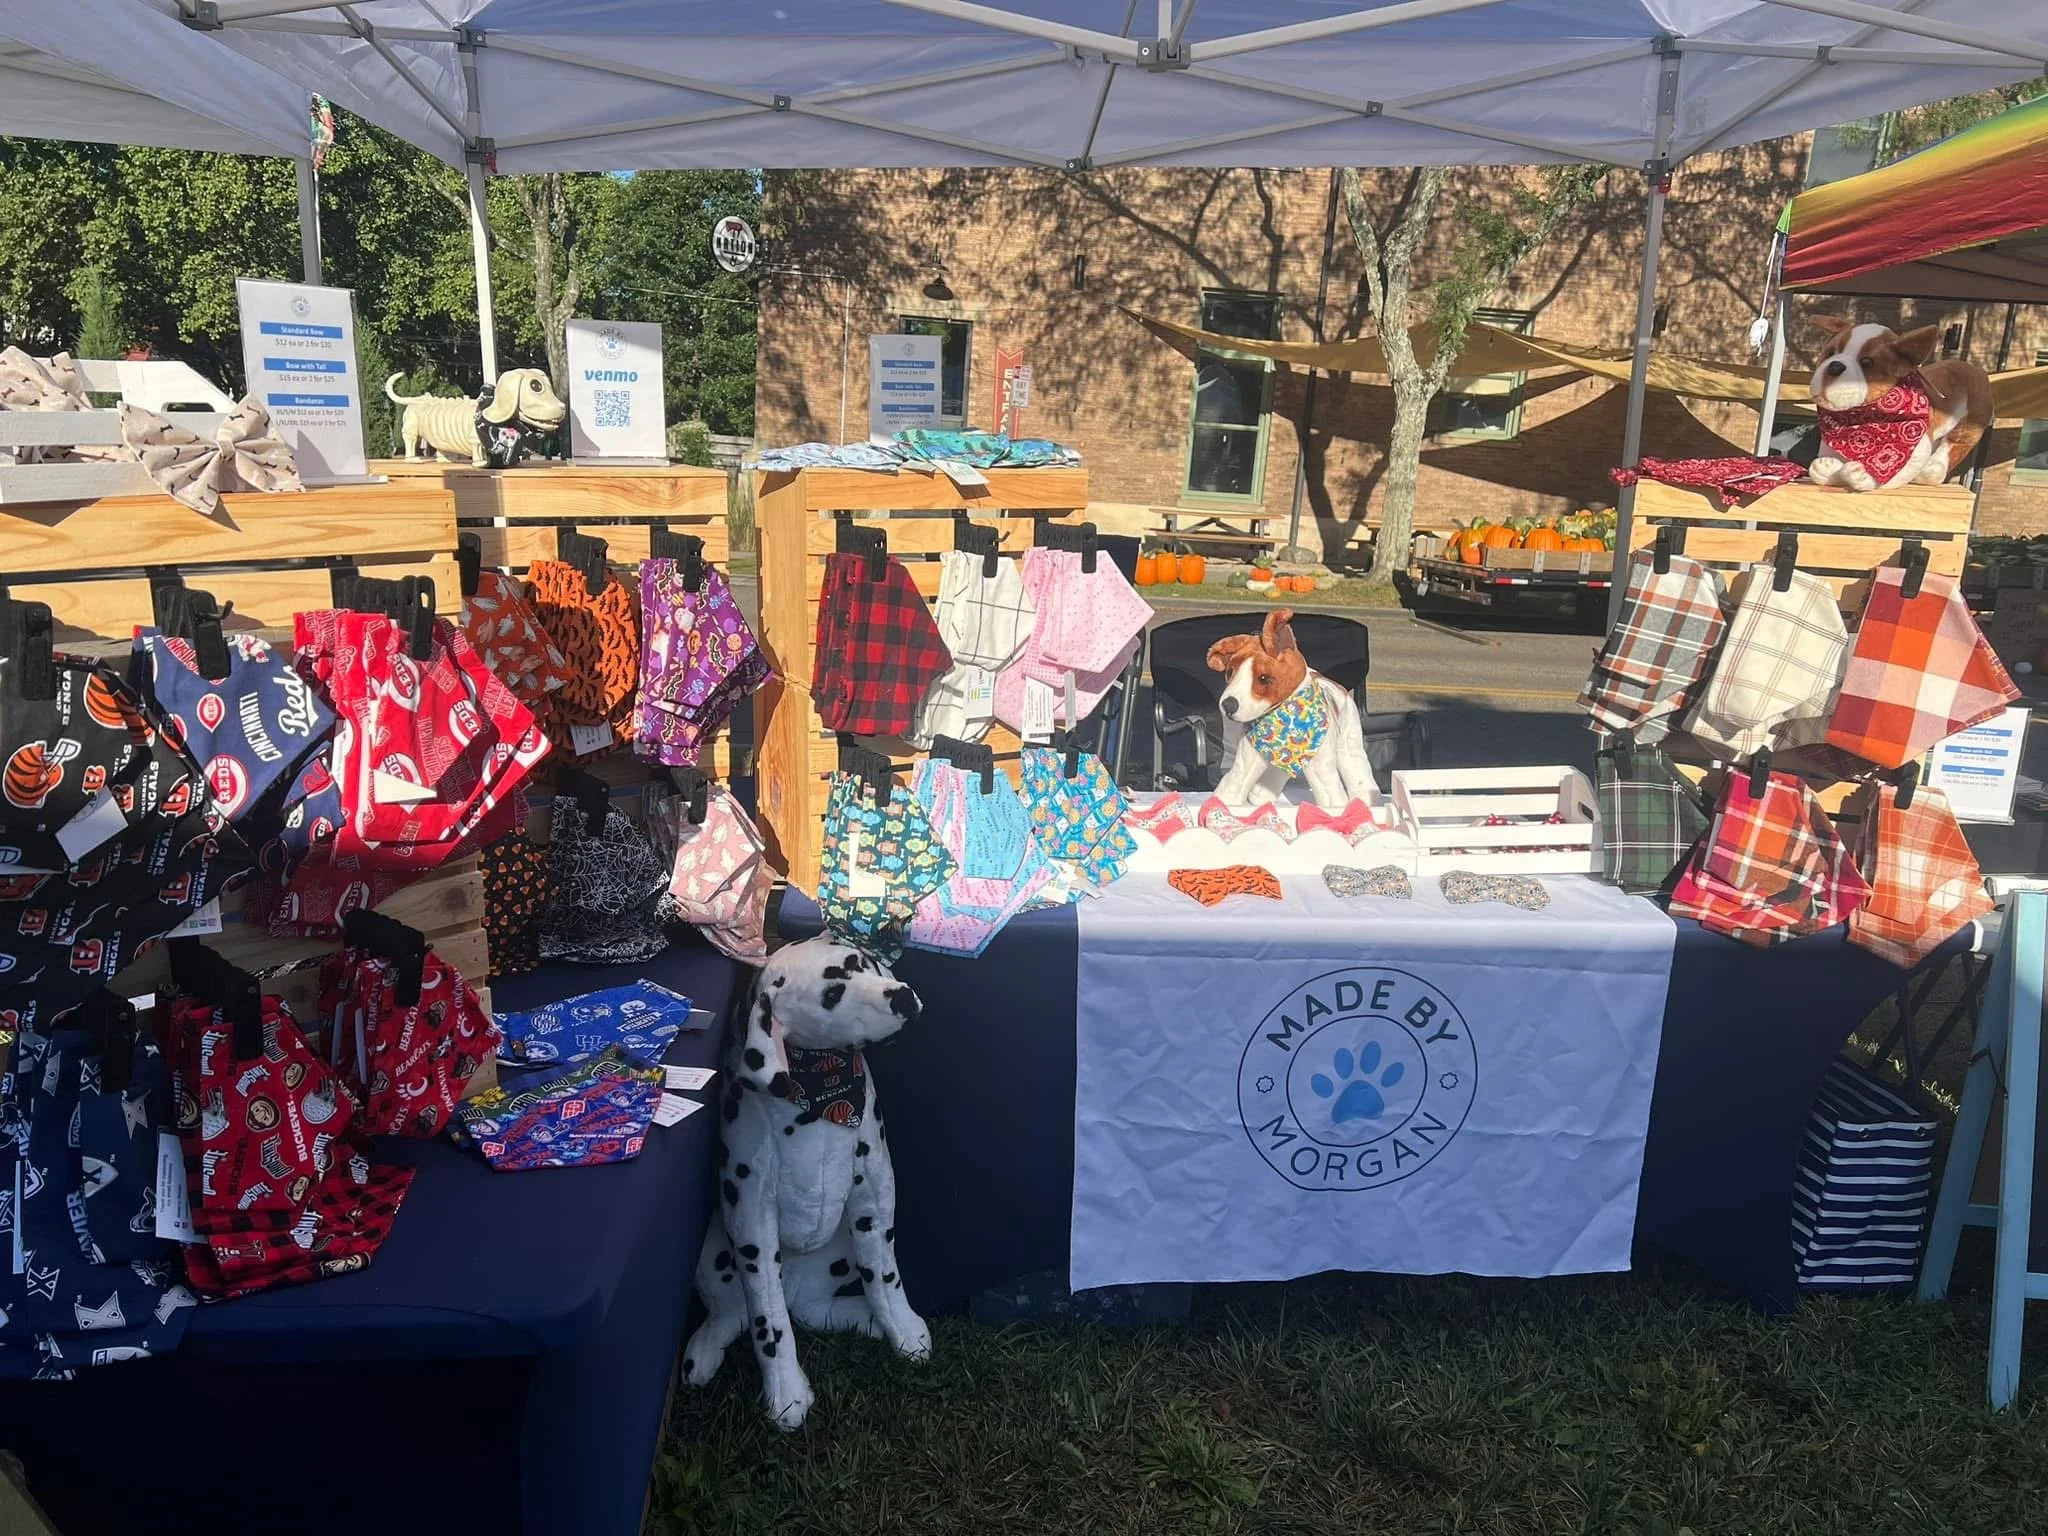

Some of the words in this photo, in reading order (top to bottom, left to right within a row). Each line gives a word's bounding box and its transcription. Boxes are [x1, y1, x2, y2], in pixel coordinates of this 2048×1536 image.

[717, 237, 753, 254] NATION
[276, 338, 287, 346] $12
[281, 326, 310, 335] Standard
[280, 374, 290, 382] $15
[584, 370, 638, 382] venmo
[239, 692, 282, 762] CINCINNATI
[216, 757, 232, 802] REDS
[1266, 980, 1396, 1052] MADE
[1404, 996, 1458, 1044] BY
[394, 1040, 432, 1078] BEARCATS
[1258, 1112, 1448, 1182] MORGAN
